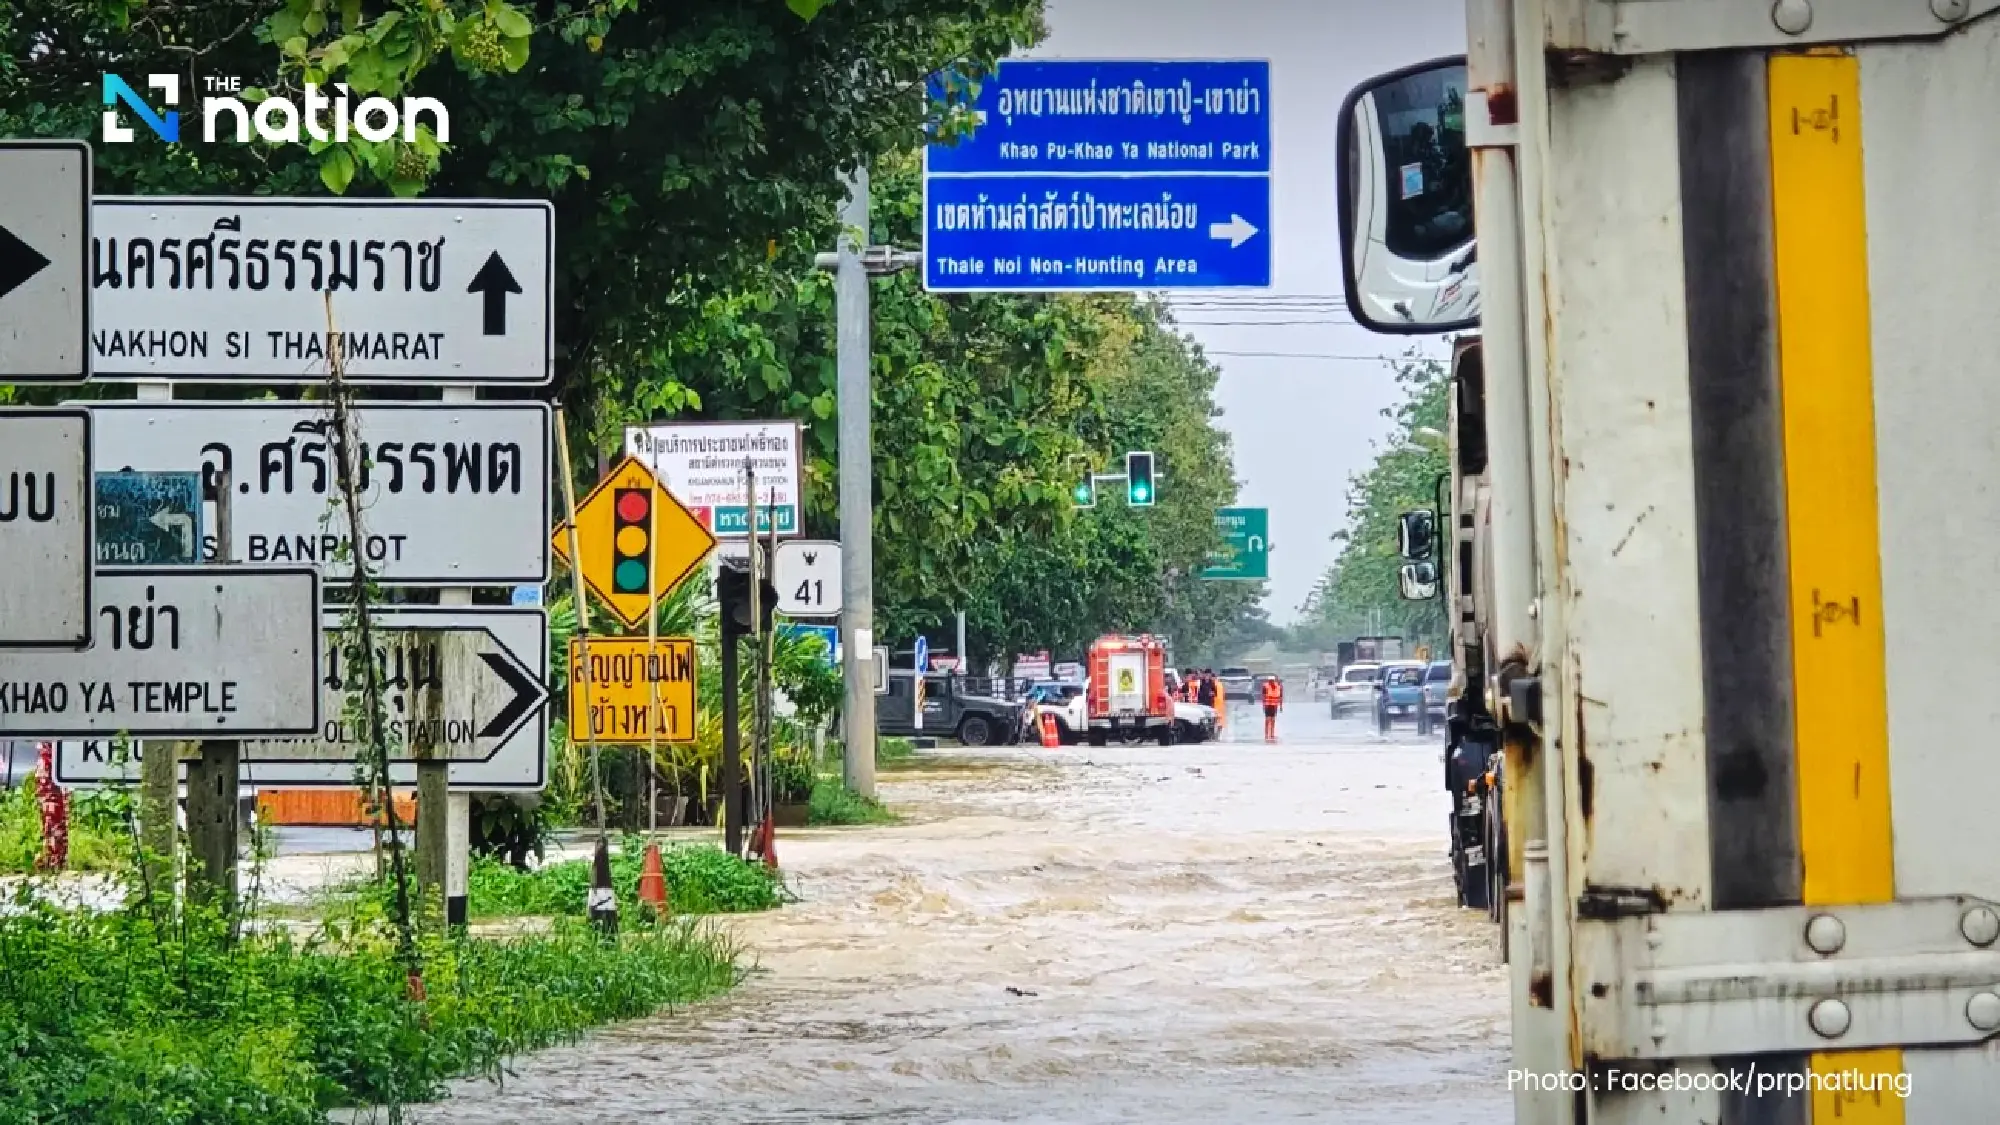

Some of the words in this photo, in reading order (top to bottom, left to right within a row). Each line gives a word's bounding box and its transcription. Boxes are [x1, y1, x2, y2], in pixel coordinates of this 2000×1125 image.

[1000, 142, 1038, 159] Khao
[1047, 142, 1113, 159] Pu-Khao
[1121, 142, 1139, 159] Ya
[1148, 142, 1213, 159] National
[1222, 142, 1259, 159] Park
[92, 215, 445, 292] นครศรีธรรมราช
[937, 257, 985, 275] Thale
[994, 257, 1021, 275] Noi
[1030, 257, 1144, 279] Non-Hunting
[1155, 257, 1198, 275] Area
[92, 330, 208, 359] NAKHON
[225, 330, 250, 360] SI
[794, 579, 822, 605] 41
[79, 681, 116, 714] YA
[127, 681, 238, 714] TEMPLE
[390, 719, 476, 744] STATION
